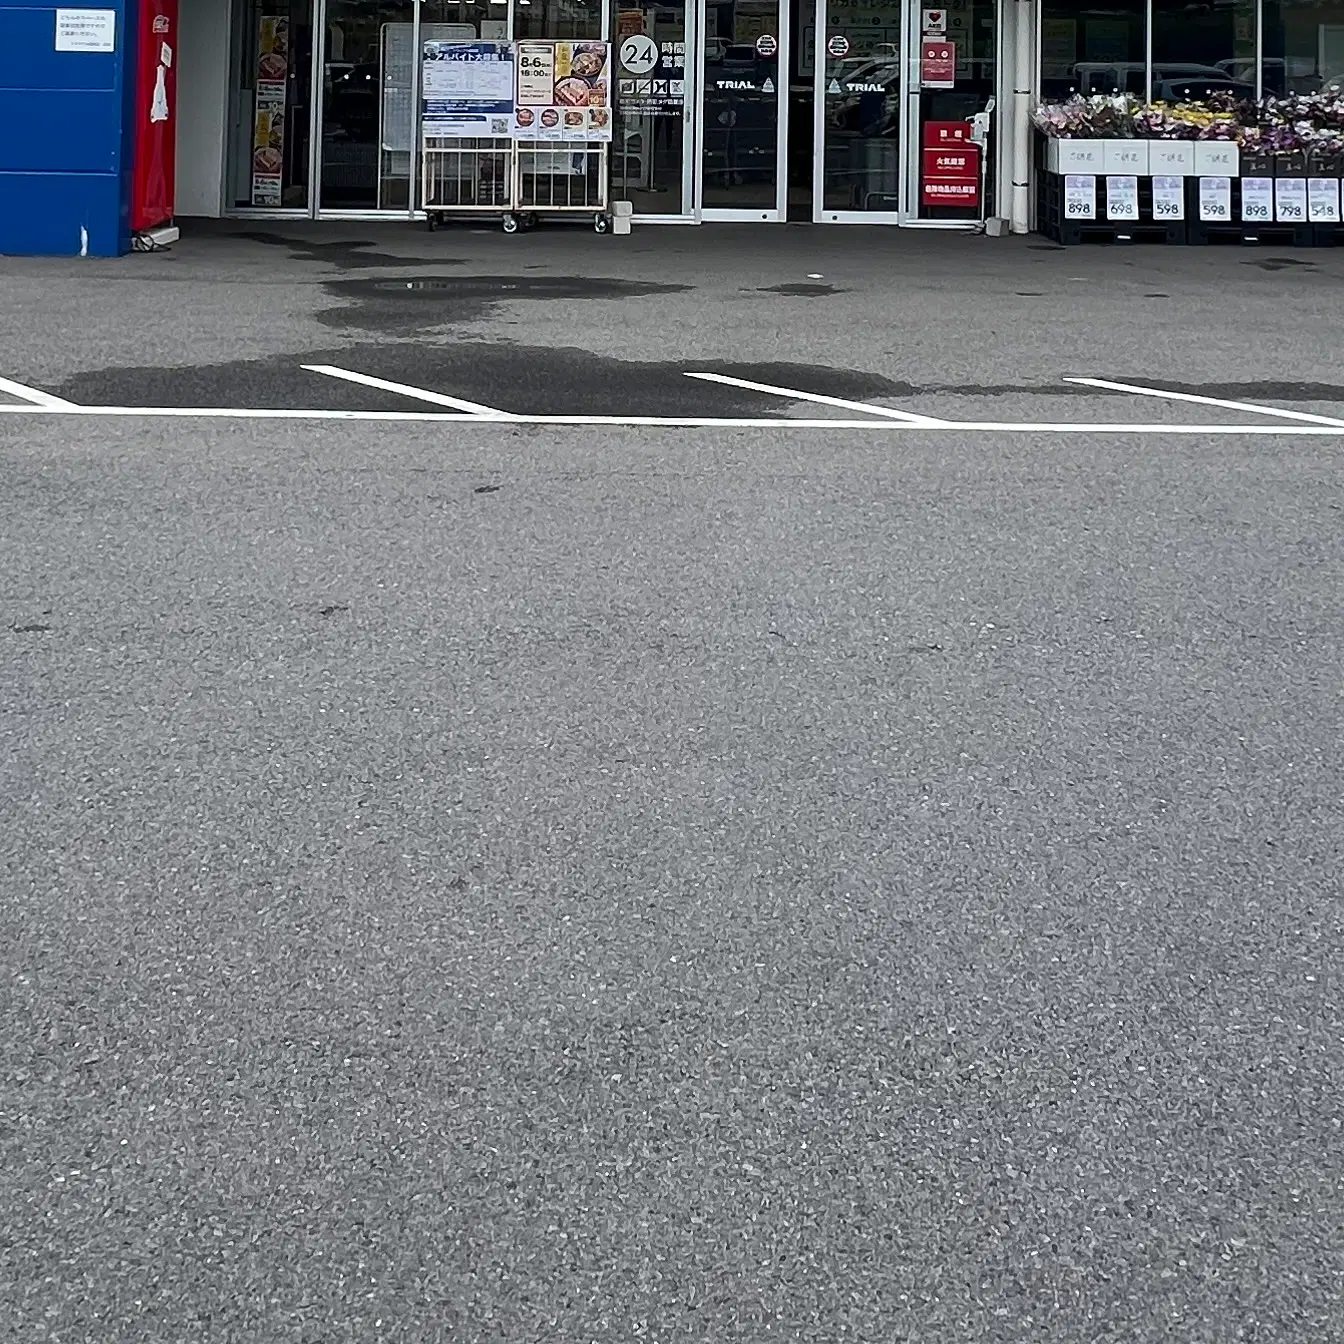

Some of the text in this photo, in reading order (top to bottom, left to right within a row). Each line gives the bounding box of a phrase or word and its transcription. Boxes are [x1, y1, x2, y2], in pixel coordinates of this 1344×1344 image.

[661, 42, 685, 54] 時間
[625, 44, 654, 64] 24
[661, 55, 685, 67] 営業
[717, 80, 755, 89] TRIAL
[846, 83, 885, 92] TRIAL
[1069, 203, 1090, 214] 898
[1110, 203, 1133, 214] 698
[1156, 204, 1179, 214] 598
[1203, 205, 1226, 215] 598
[1245, 206, 1268, 216] 898
[1281, 206, 1302, 216] 798
[1311, 206, 1334, 216] 548
